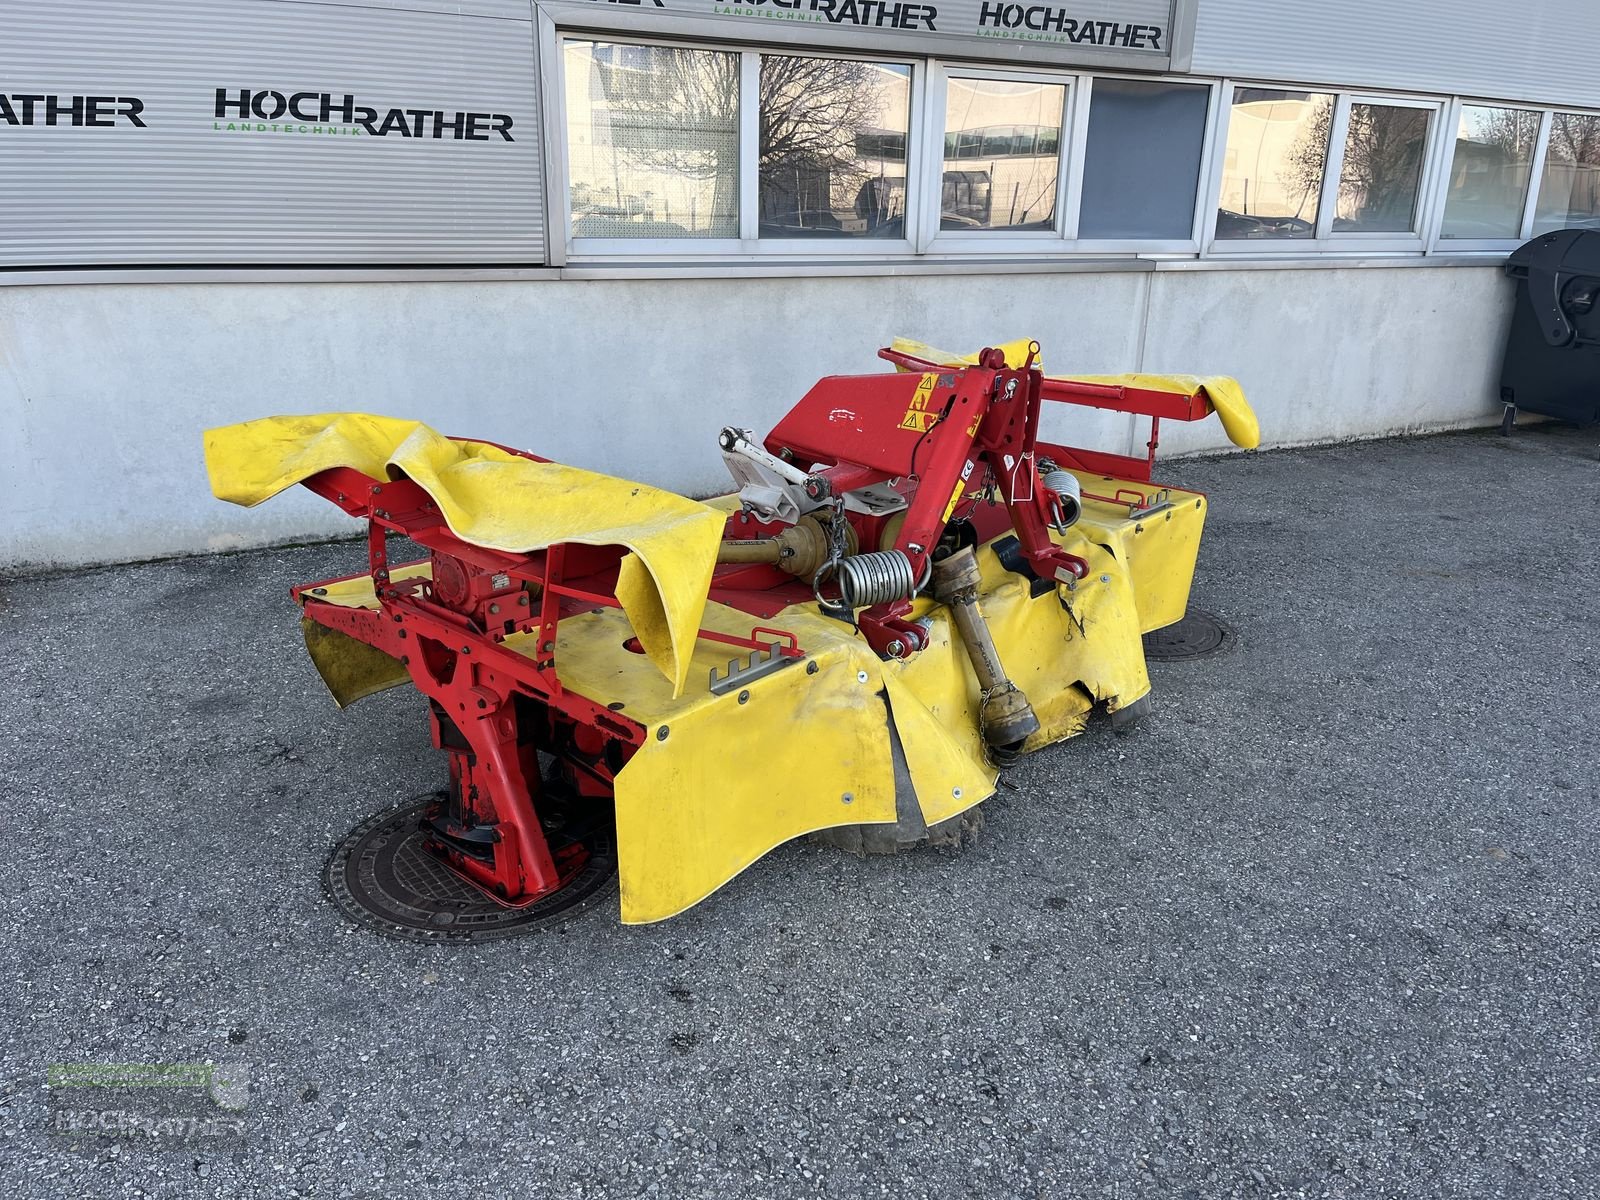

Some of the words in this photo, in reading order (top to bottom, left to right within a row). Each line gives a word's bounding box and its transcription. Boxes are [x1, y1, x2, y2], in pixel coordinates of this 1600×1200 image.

[714, 6, 823, 22] LANDTECHNIK
[715, 0, 938, 31] RATHER
[979, 1, 1162, 50] HOCHRATHER
[976, 29, 1066, 43] LANDTECHNIK
[215, 88, 515, 142] HOCHRATHER
[213, 122, 361, 136] LANDTECHNIK
